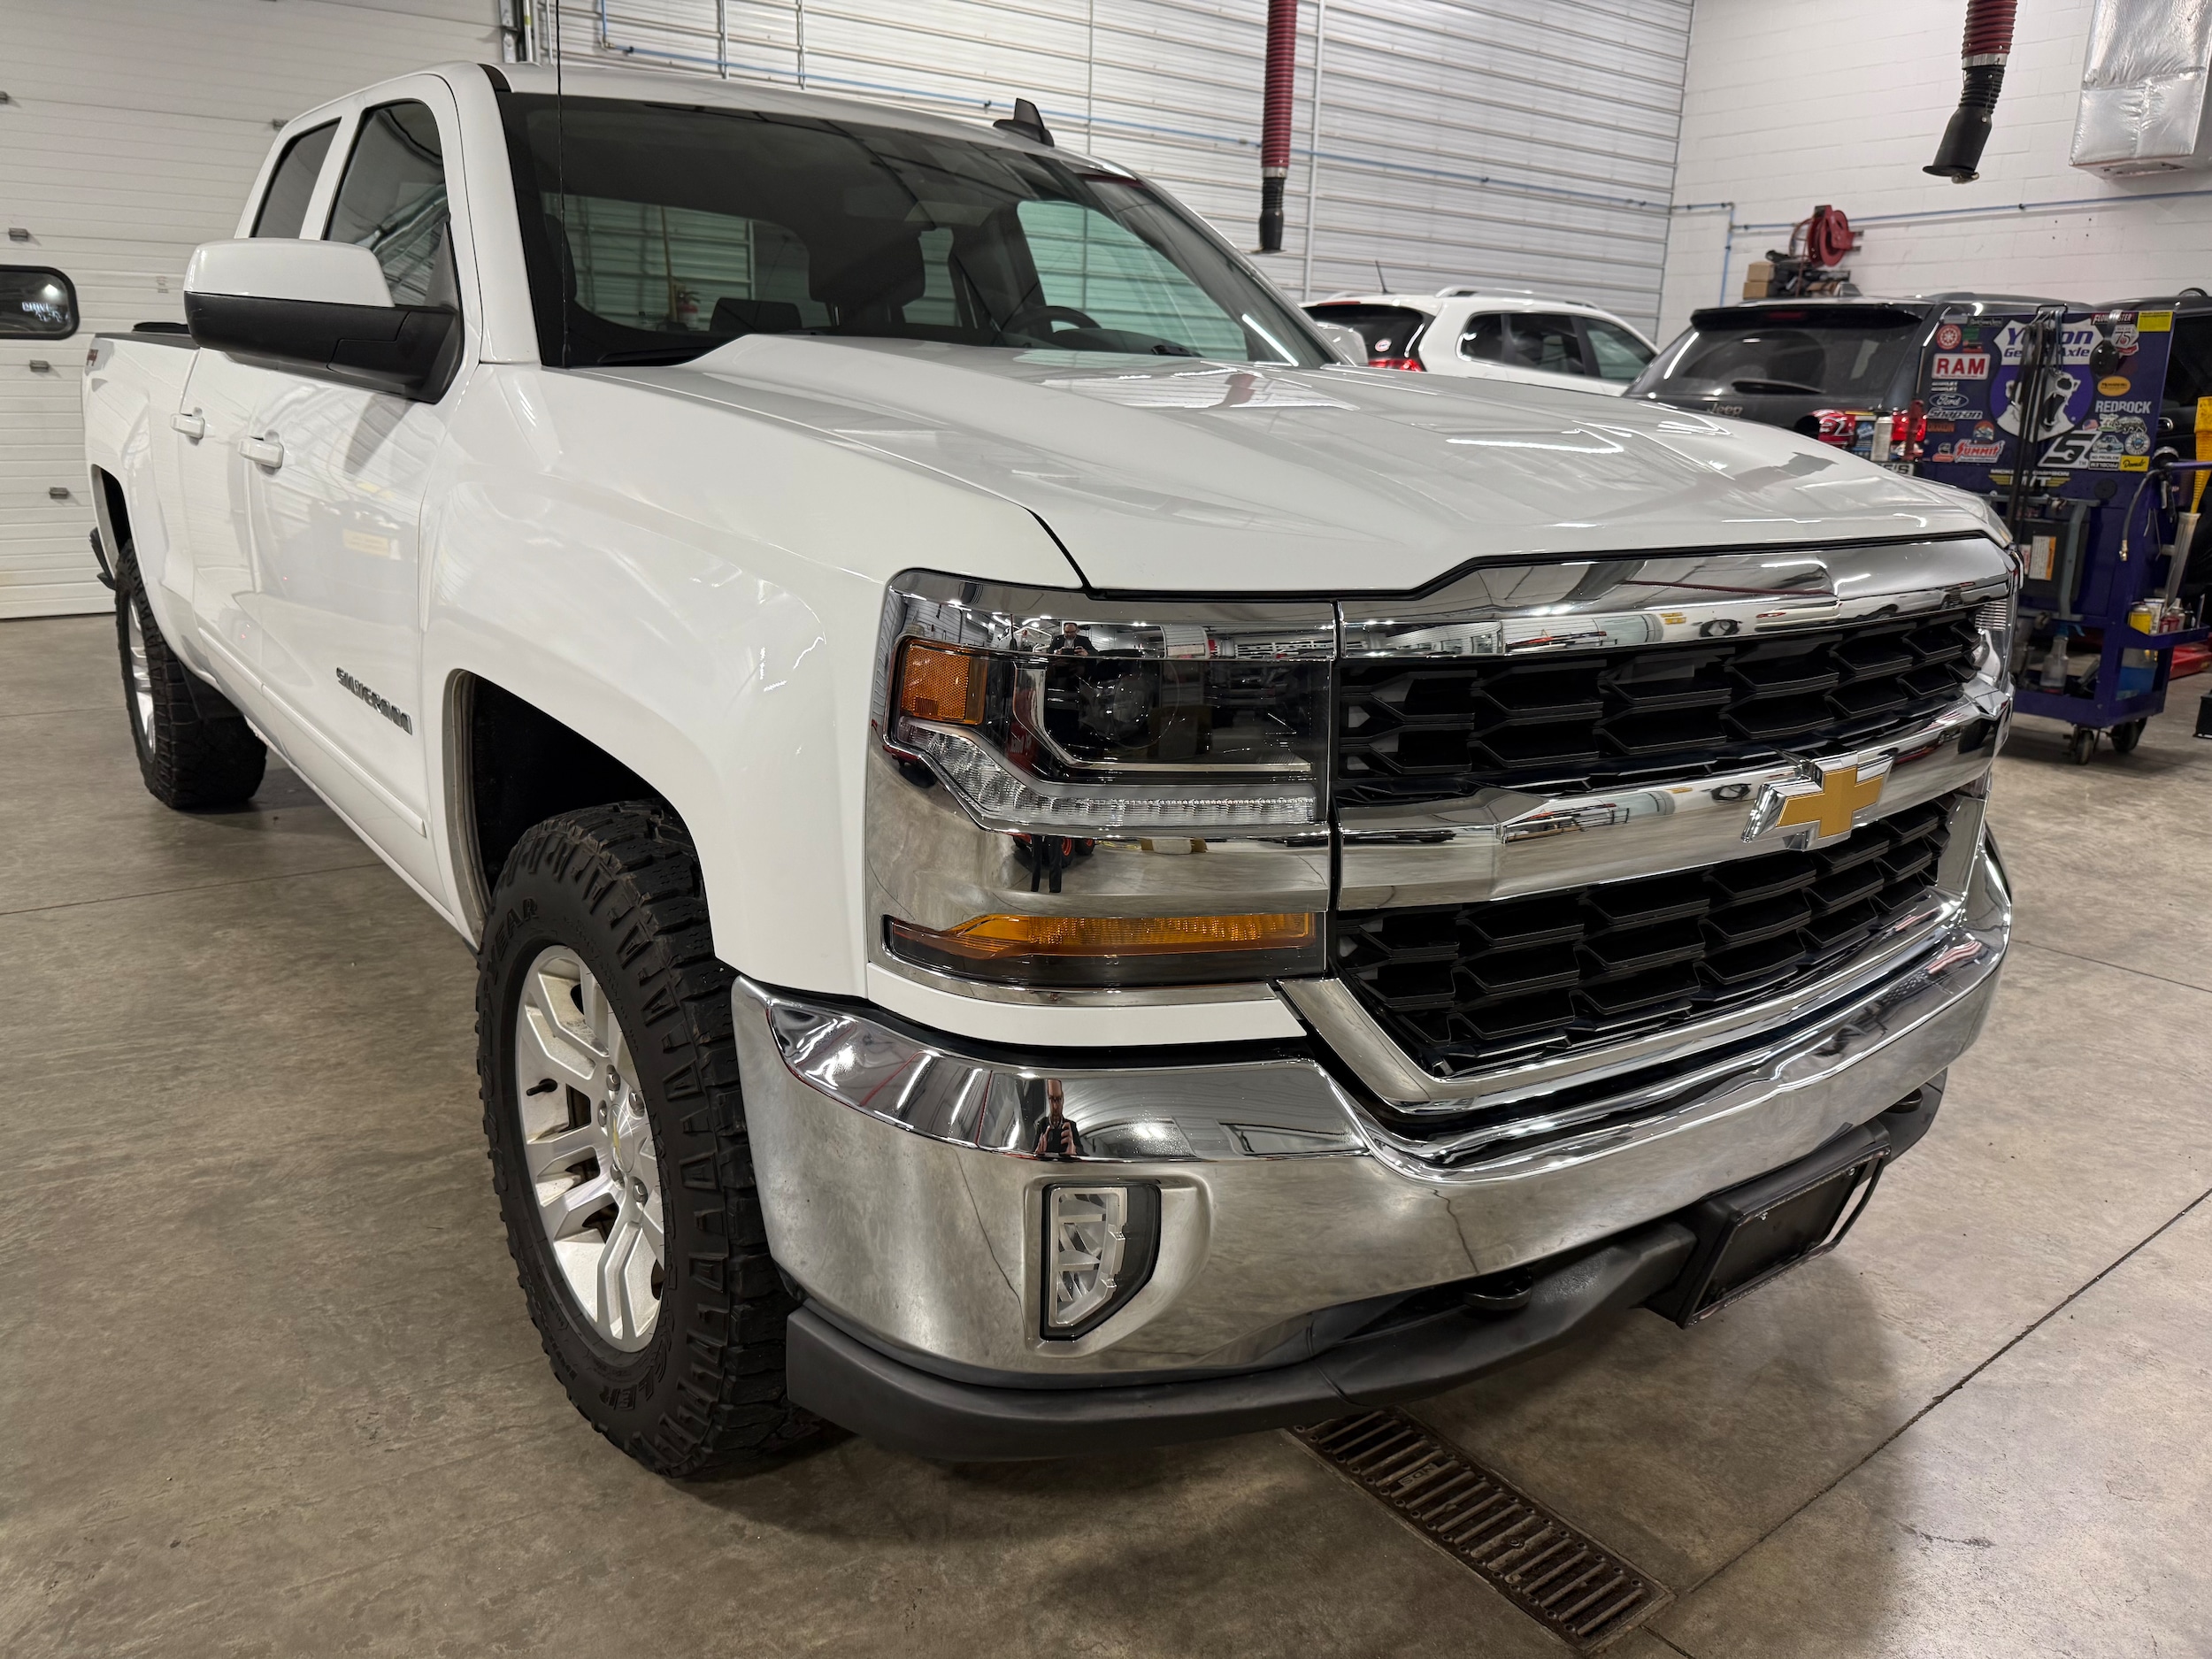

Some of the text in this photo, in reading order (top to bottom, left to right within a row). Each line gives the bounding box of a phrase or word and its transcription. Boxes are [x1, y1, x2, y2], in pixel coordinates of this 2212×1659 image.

[1936, 357, 1985, 375] RAM
[1936, 395, 1962, 406] Ford
[2094, 400, 2152, 414] REDROCK
